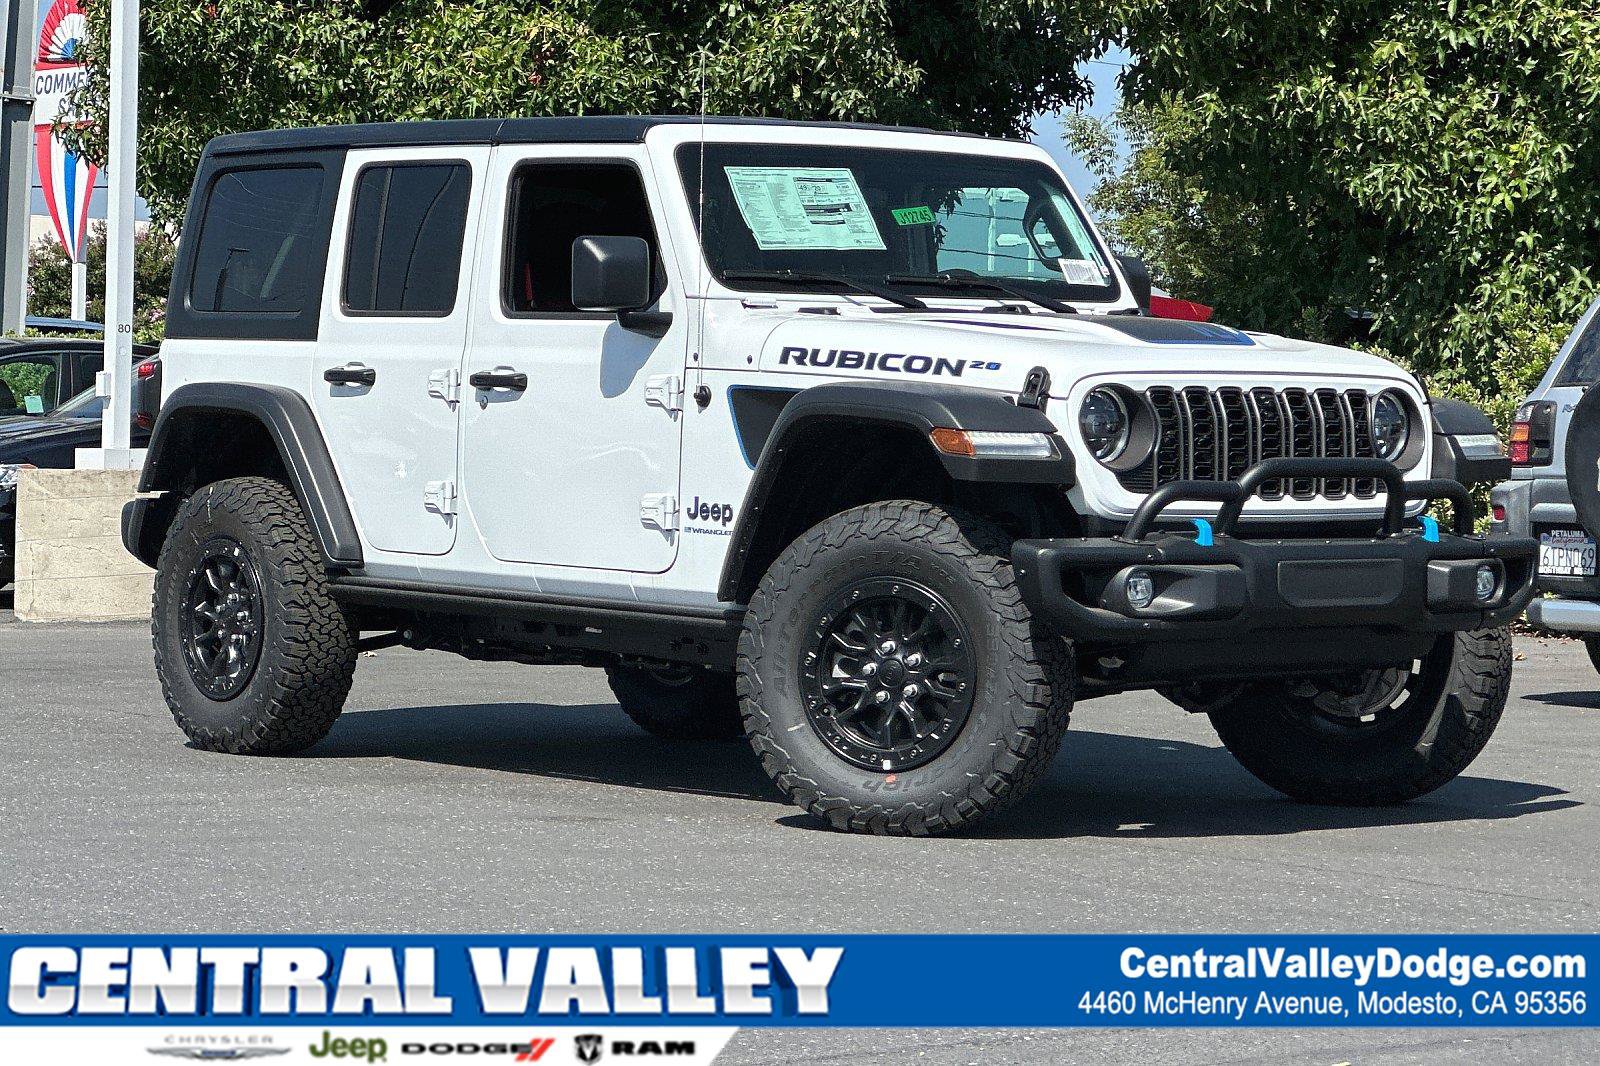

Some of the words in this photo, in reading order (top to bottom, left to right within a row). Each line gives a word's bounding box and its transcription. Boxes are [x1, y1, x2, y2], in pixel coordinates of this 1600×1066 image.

[35, 71, 90, 95] COMME
[117, 324, 131, 334] 80
[778, 346, 967, 377] RUBICON
[687, 495, 734, 527] Jeep
